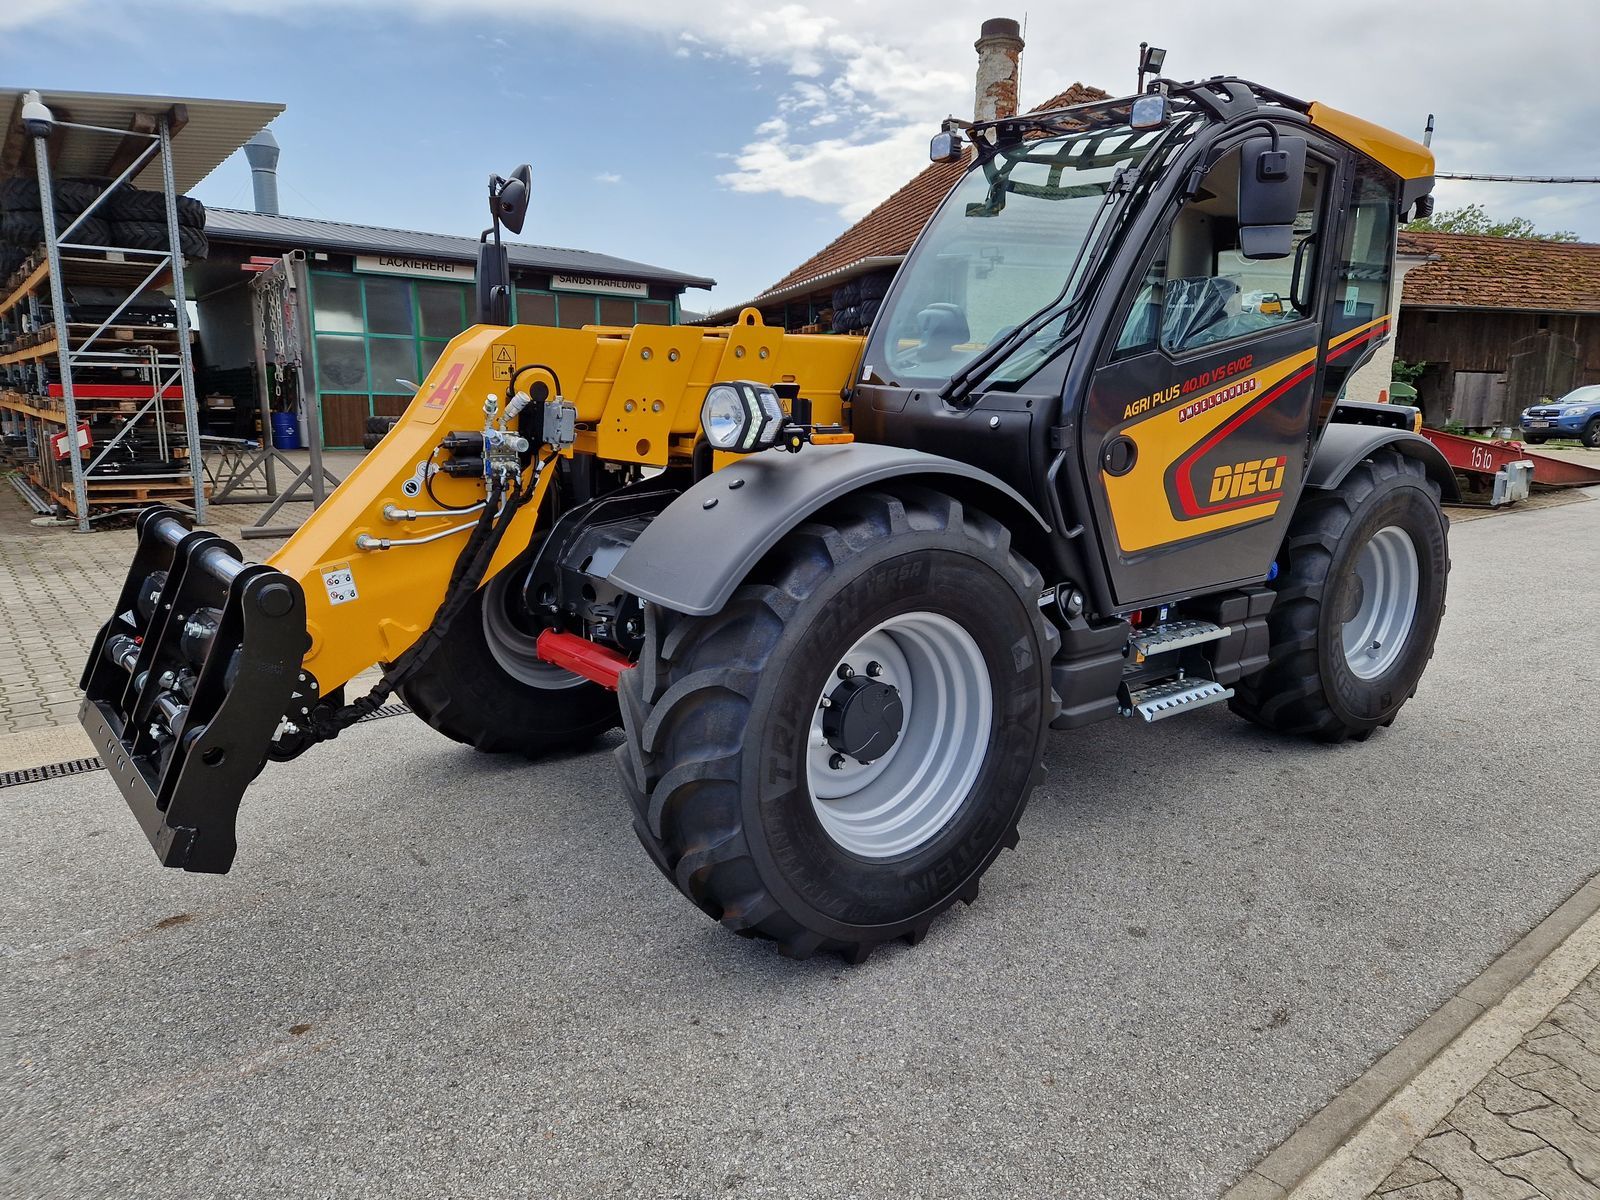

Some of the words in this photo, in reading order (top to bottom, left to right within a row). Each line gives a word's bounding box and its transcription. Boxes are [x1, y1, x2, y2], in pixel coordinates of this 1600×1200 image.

[379, 258, 455, 273] LACKIEREREI
[1123, 396, 1150, 419] AGRI
[1152, 384, 1181, 407] PLUS
[1181, 373, 1210, 393] 40.10
[1211, 364, 1226, 382] VS
[1178, 378, 1256, 422] AMSELGRUBER
[1209, 456, 1287, 502] DIECI
[1471, 446, 1482, 467] 15
[1483, 449, 1492, 469] to
